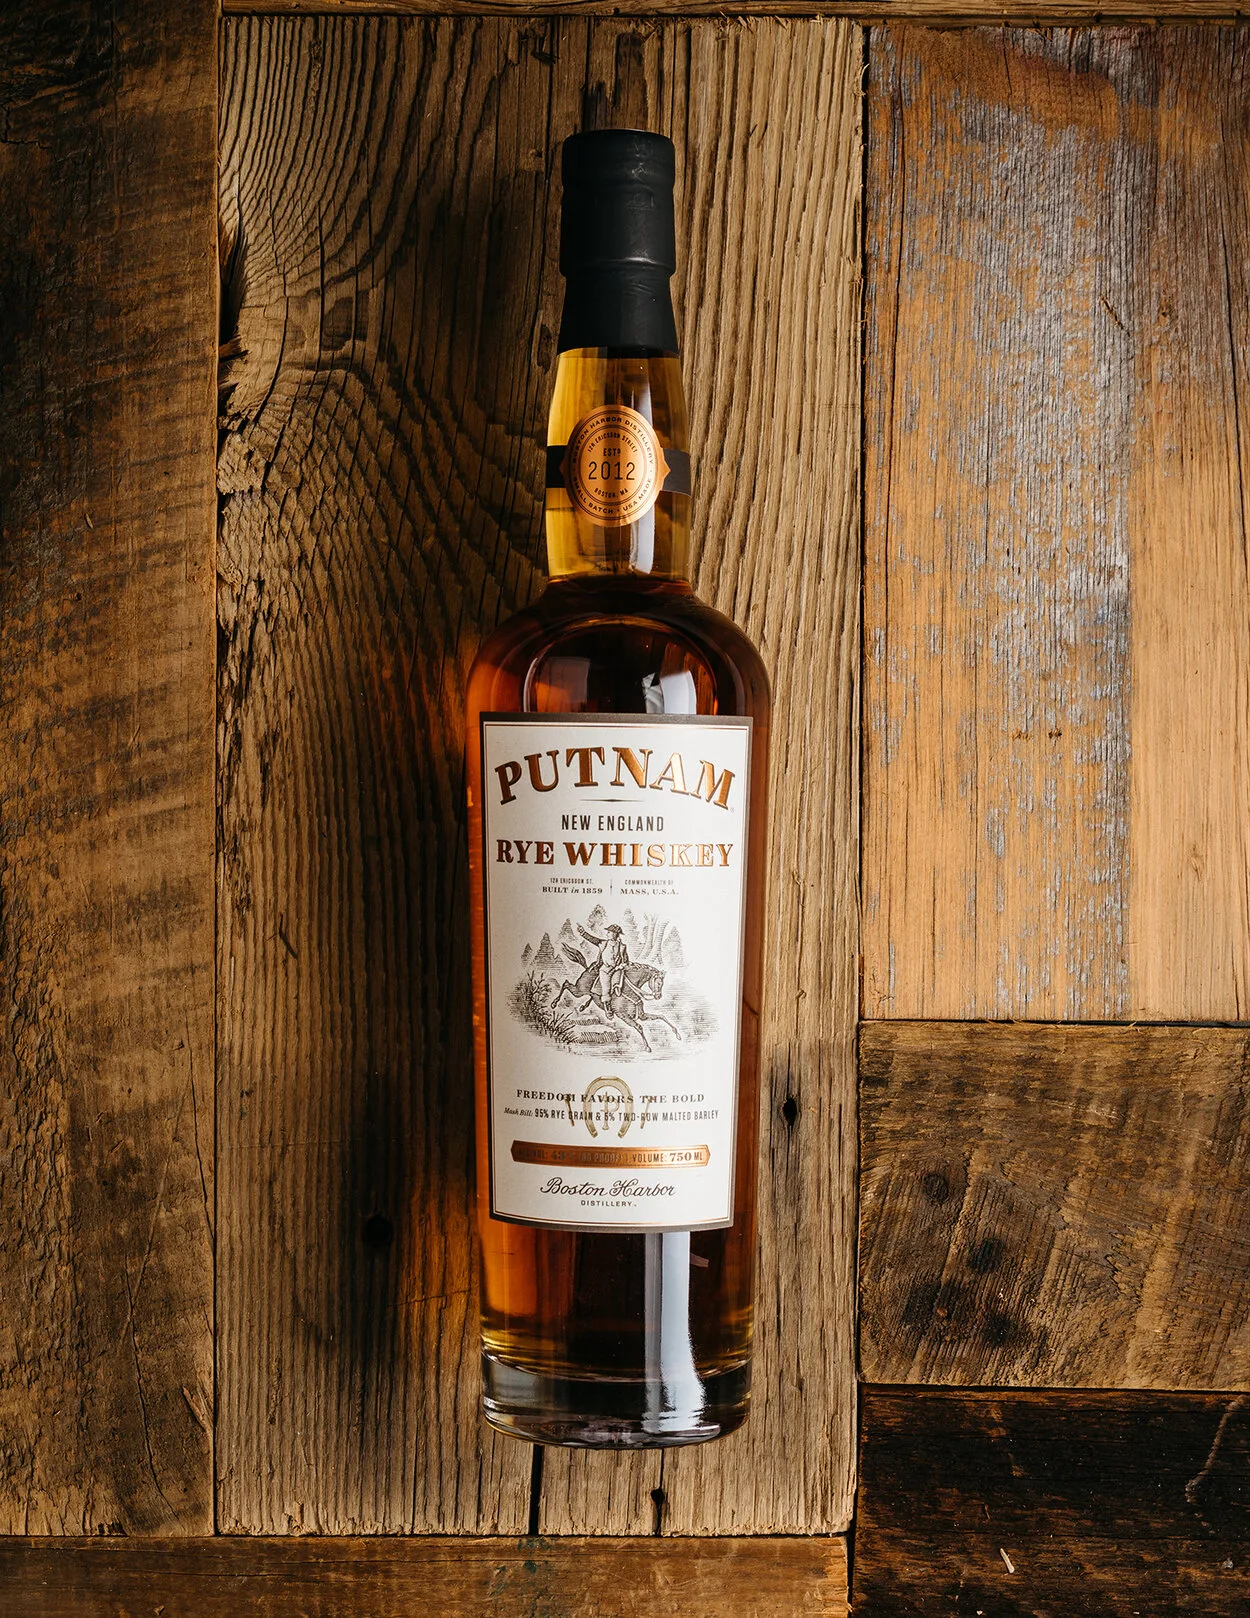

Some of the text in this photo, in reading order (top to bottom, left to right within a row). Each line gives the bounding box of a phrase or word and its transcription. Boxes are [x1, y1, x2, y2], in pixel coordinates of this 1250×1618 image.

[590, 416, 622, 428] HARBOR
[625, 419, 654, 464] DISTILLERY
[622, 435, 638, 452] STREET
[588, 461, 636, 480] 2012
[573, 476, 614, 514] SMALL BATCH
[620, 488, 628, 496] MA
[622, 478, 652, 512] USA MADE
[494, 746, 736, 811] PUTNAM
[561, 814, 665, 832] NEW ENGLAND
[496, 839, 734, 867] RYE WHISKEY
[542, 886, 568, 894] BUILT
[571, 886, 580, 894] in
[620, 888, 679, 896] MASS, U.S.A.
[516, 1089, 705, 1104] FREEDOM FAVORS THE BOLD
[504, 1106, 519, 1116] Mash
[534, 1108, 549, 1119] 95%
[551, 1110, 565, 1120] RYE
[568, 1111, 593, 1121] GRAIN
[596, 1112, 601, 1121] &
[662, 1112, 692, 1122] MALTED
[694, 1110, 719, 1120] BARLEY
[632, 1153, 667, 1163] VOLUME:
[669, 1152, 692, 1162] 750
[694, 1152, 703, 1162] ML
[540, 1176, 676, 1198] Boston Harbor
